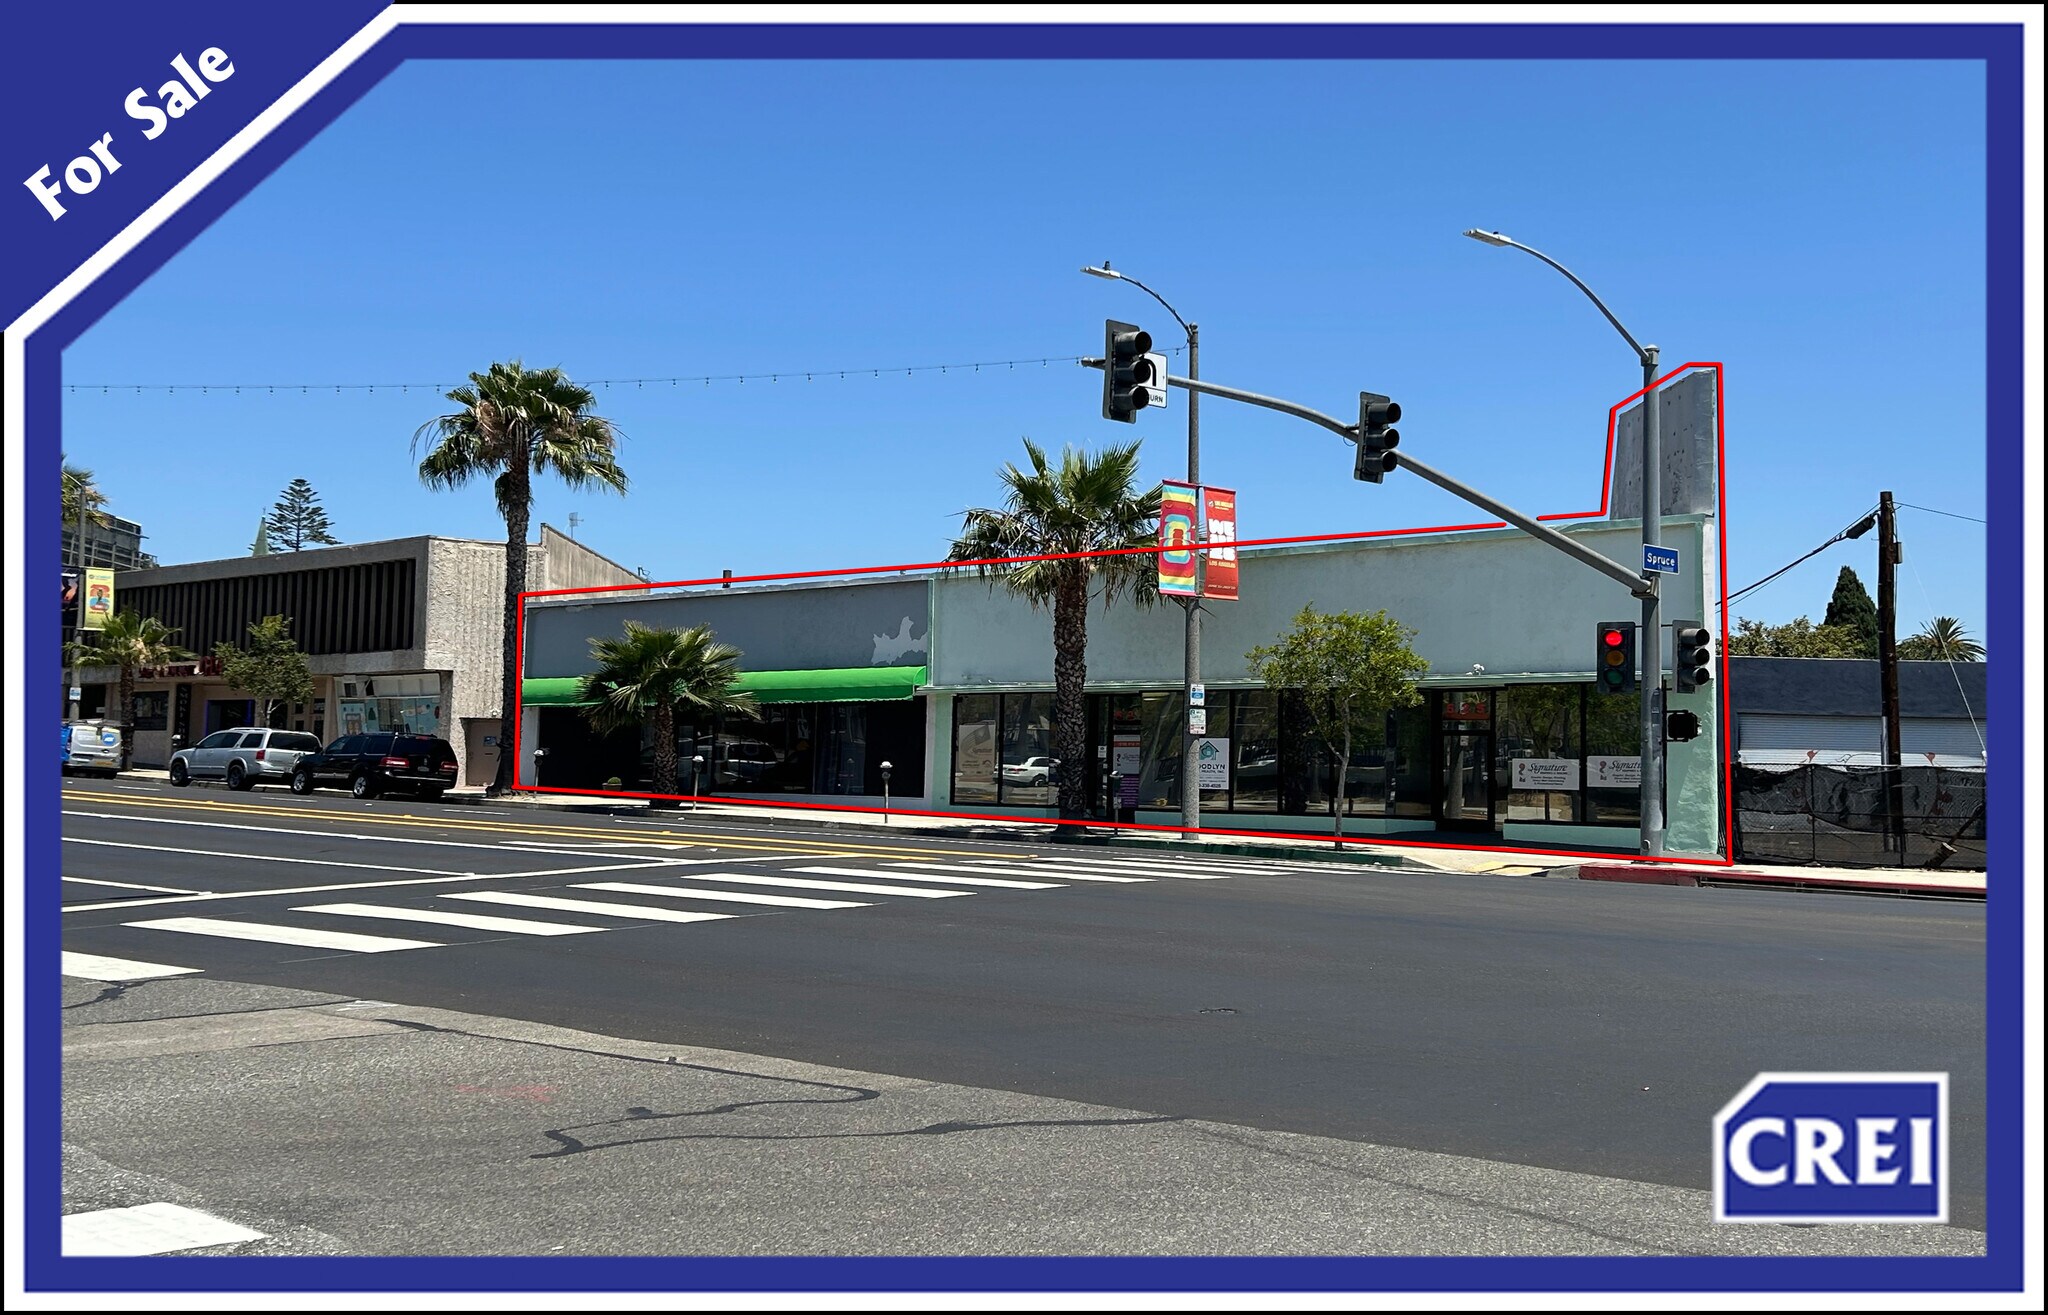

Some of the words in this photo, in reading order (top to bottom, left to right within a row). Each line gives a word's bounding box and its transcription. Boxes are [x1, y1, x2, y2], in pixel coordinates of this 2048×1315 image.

[1148, 394, 1164, 403] URN
[1646, 552, 1675, 566] Spruce
[1528, 763, 1568, 774] Signature
[1609, 760, 1641, 772] Signat
